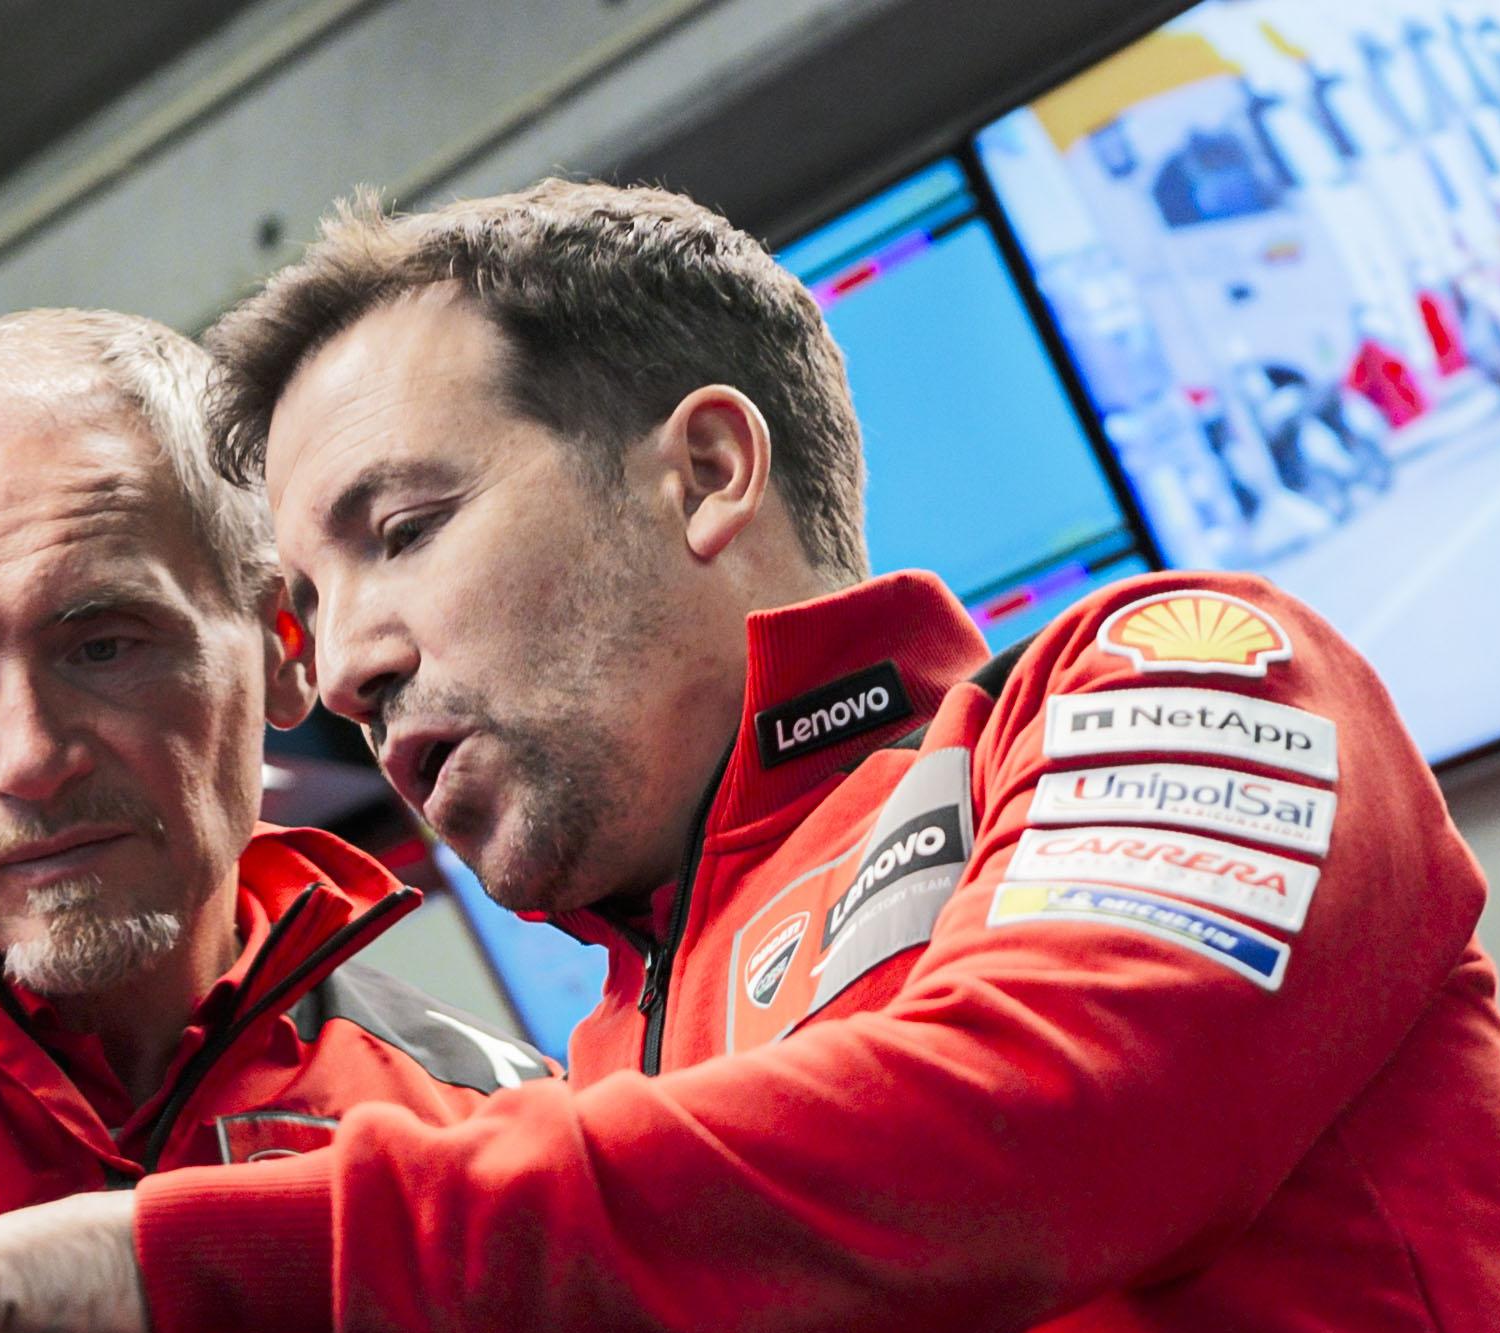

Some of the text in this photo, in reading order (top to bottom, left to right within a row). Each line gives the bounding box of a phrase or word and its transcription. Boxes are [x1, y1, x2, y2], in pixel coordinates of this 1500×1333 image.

[775, 684, 890, 751] Lenovo
[1130, 704, 1312, 751] NetApp
[1073, 772, 1316, 829] UnipolSai
[829, 825, 947, 935] Lenovo
[909, 876, 953, 897] TEAM
[1035, 837, 1288, 898] CARRERA
[749, 918, 803, 972] DUCATI
[1099, 896, 1240, 950] MICHELIN
